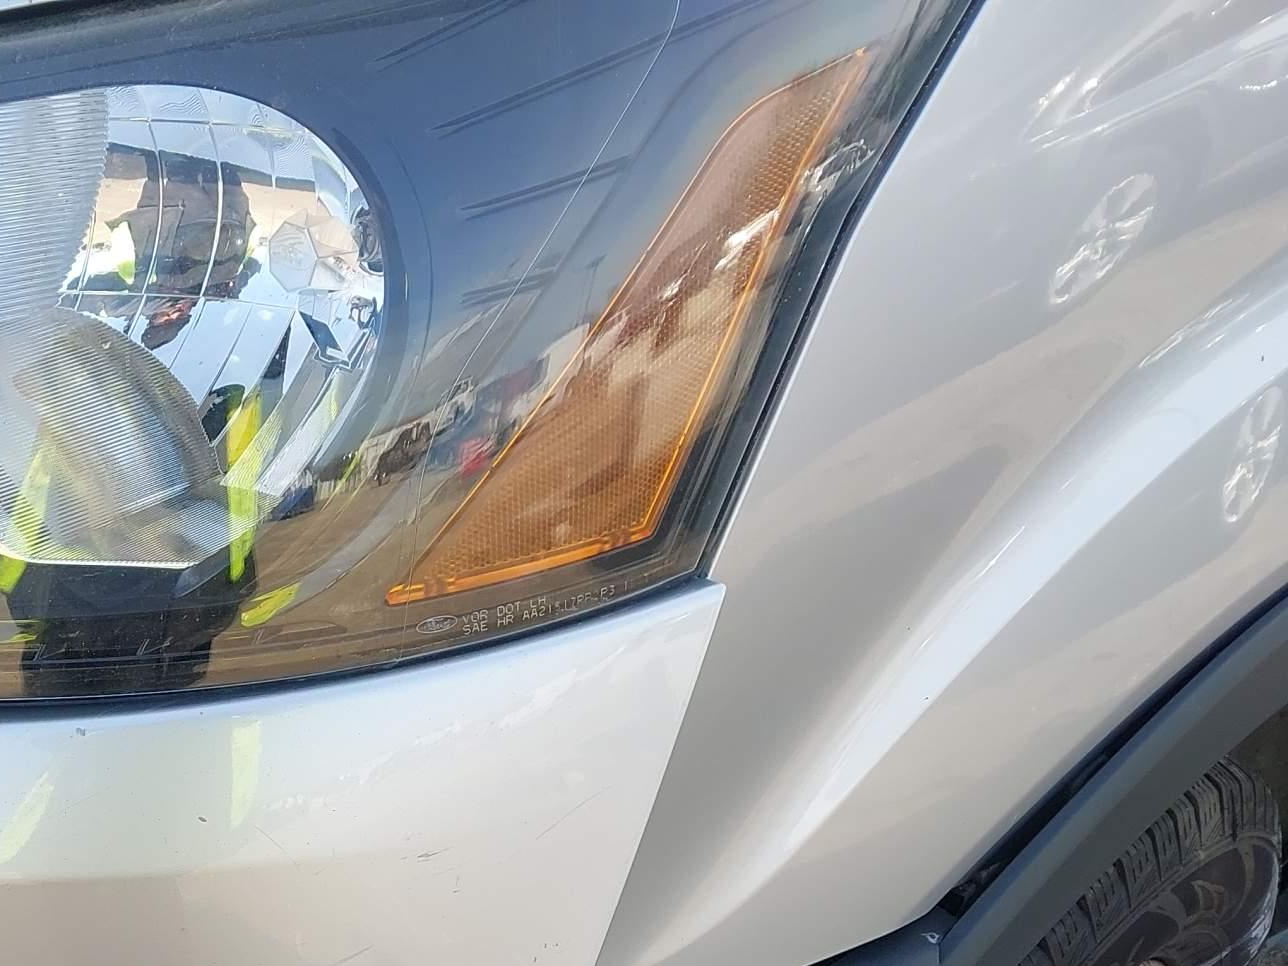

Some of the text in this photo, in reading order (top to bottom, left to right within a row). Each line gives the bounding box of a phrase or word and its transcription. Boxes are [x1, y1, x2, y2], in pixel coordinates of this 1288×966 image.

[496, 601, 521, 617] DOT
[529, 595, 546, 608] LH
[462, 621, 488, 635] SAE
[497, 615, 514, 628] HR
